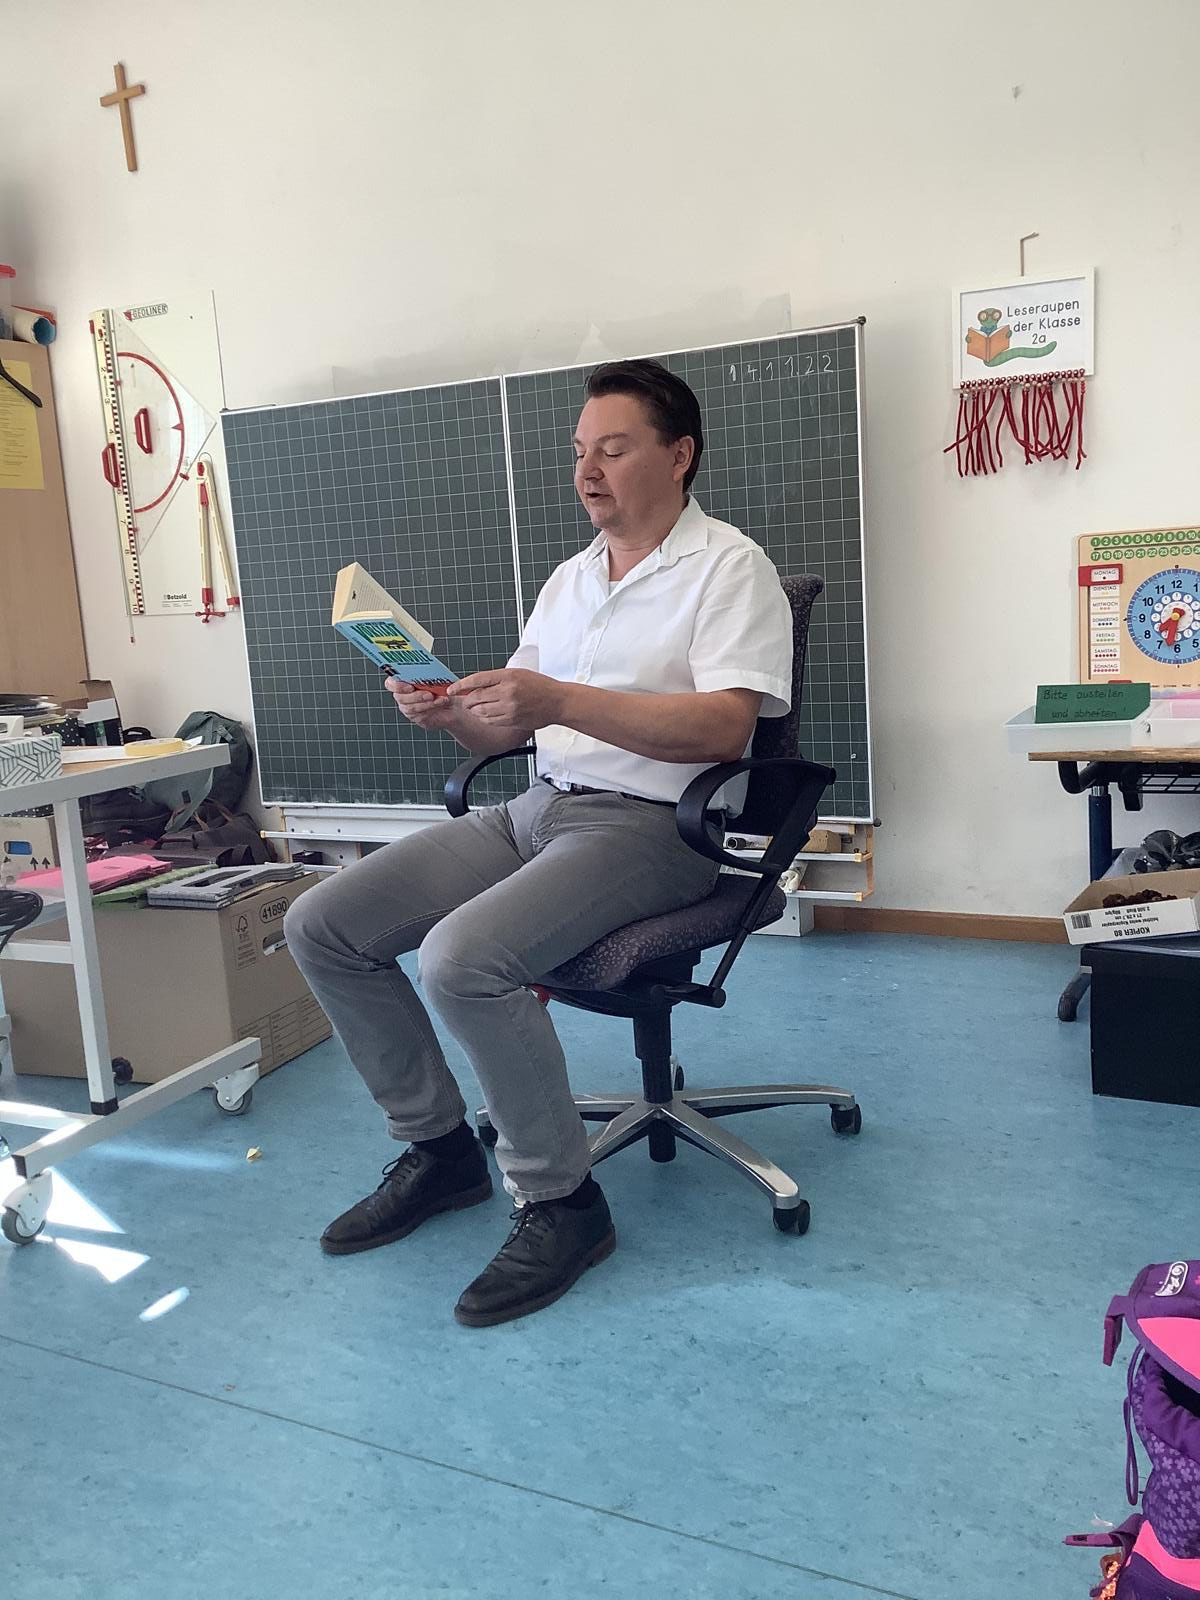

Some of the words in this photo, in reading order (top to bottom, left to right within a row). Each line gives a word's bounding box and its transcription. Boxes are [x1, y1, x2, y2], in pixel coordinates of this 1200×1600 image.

[132, 304, 168, 318] GEOLINER
[1007, 300, 1080, 317] Leseraupen
[1013, 321, 1033, 333] der
[1039, 316, 1081, 330] Klasse
[1031, 333, 1047, 345] 2a
[1155, 584, 1165, 594] 11
[1170, 579, 1183, 589] 12
[1193, 583, 1198, 592] 1
[1142, 596, 1154, 607] 10
[1138, 613, 1146, 622] 9
[1144, 629, 1151, 639] 8
[1156, 640, 1163, 649] 7
[1173, 643, 1181, 653] 6
[1192, 639, 1199, 648] 5
[1043, 689, 1068, 700] Bitte
[262, 900, 287, 919] 41890
[1113, 929, 1123, 937] 80
[1124, 926, 1151, 936] KOPIER
